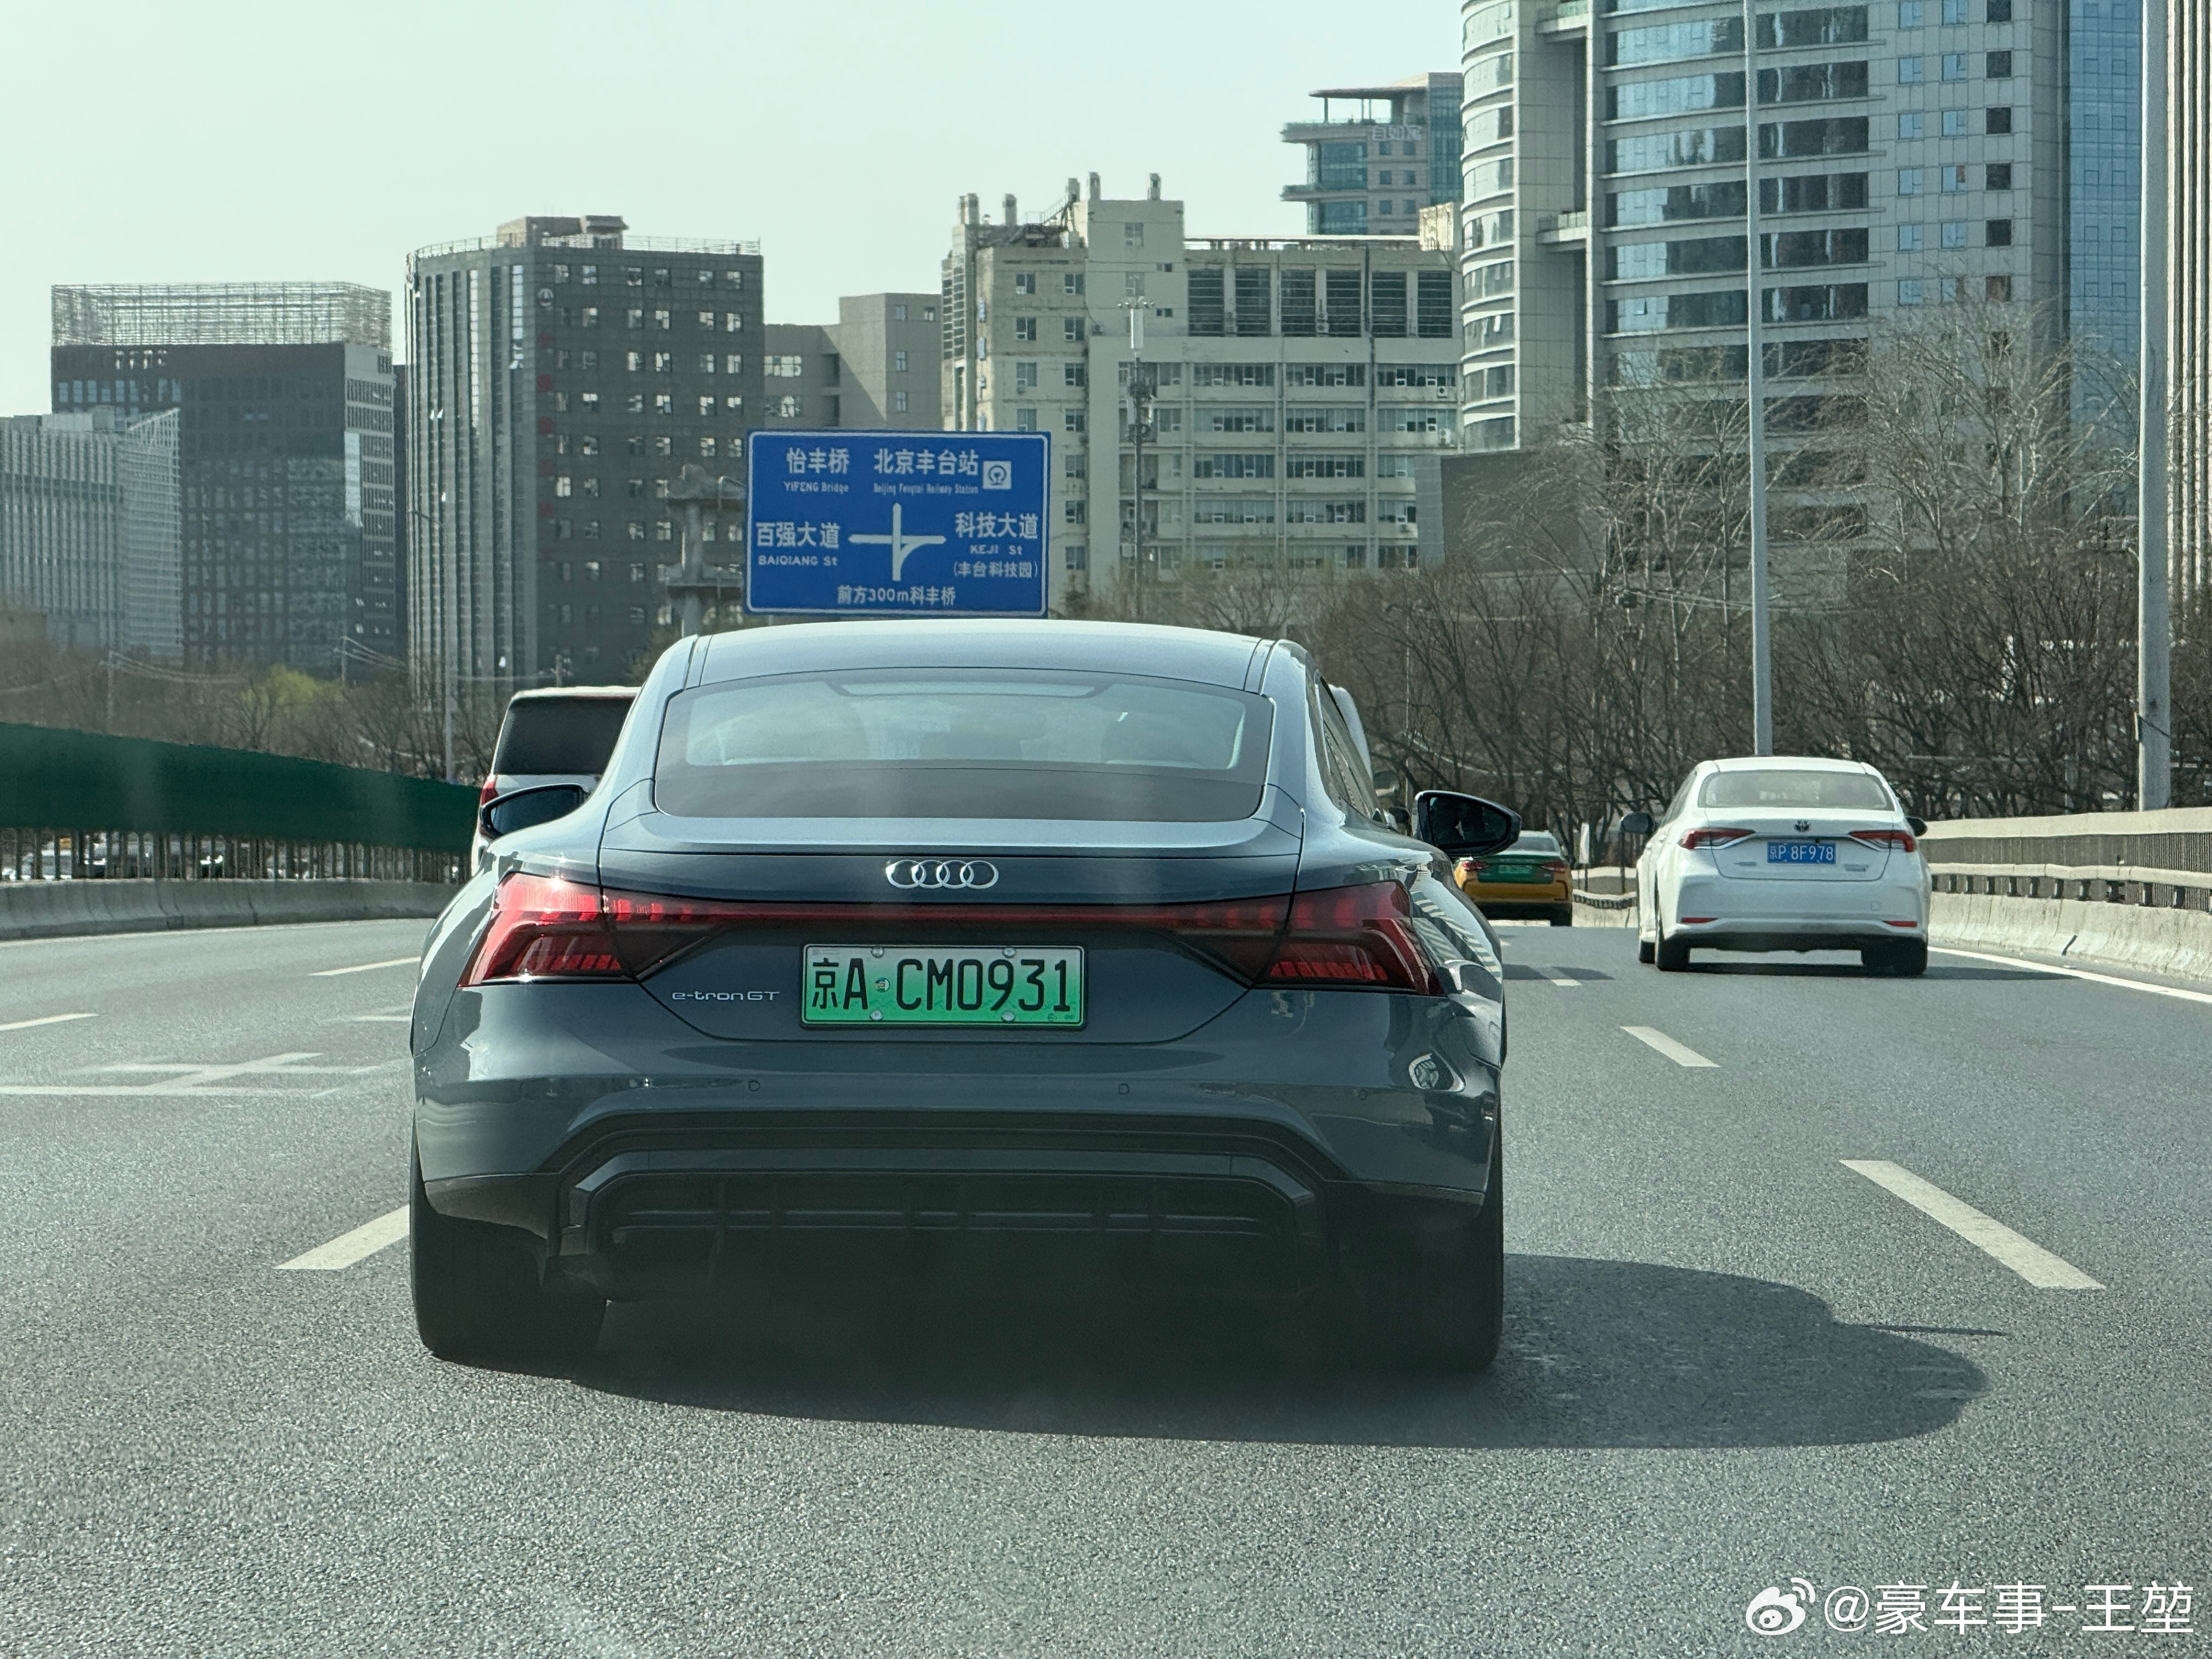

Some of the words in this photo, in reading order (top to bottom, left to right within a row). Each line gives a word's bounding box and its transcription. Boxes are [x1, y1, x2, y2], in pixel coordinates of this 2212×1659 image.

[786, 447, 849, 474] 怡丰桥
[873, 448, 979, 476] 北京丰台站
[783, 481, 819, 492] YIFENG
[821, 481, 849, 494] Bridge
[955, 483, 979, 494] Station
[756, 521, 840, 549] 百强大道
[955, 511, 1039, 540] 科技大道
[970, 545, 998, 554] KEJI
[1009, 545, 1023, 555] St
[758, 555, 818, 566] BAIQIANG
[823, 556, 838, 566] St
[837, 585, 956, 605] 前方300m科丰桥
